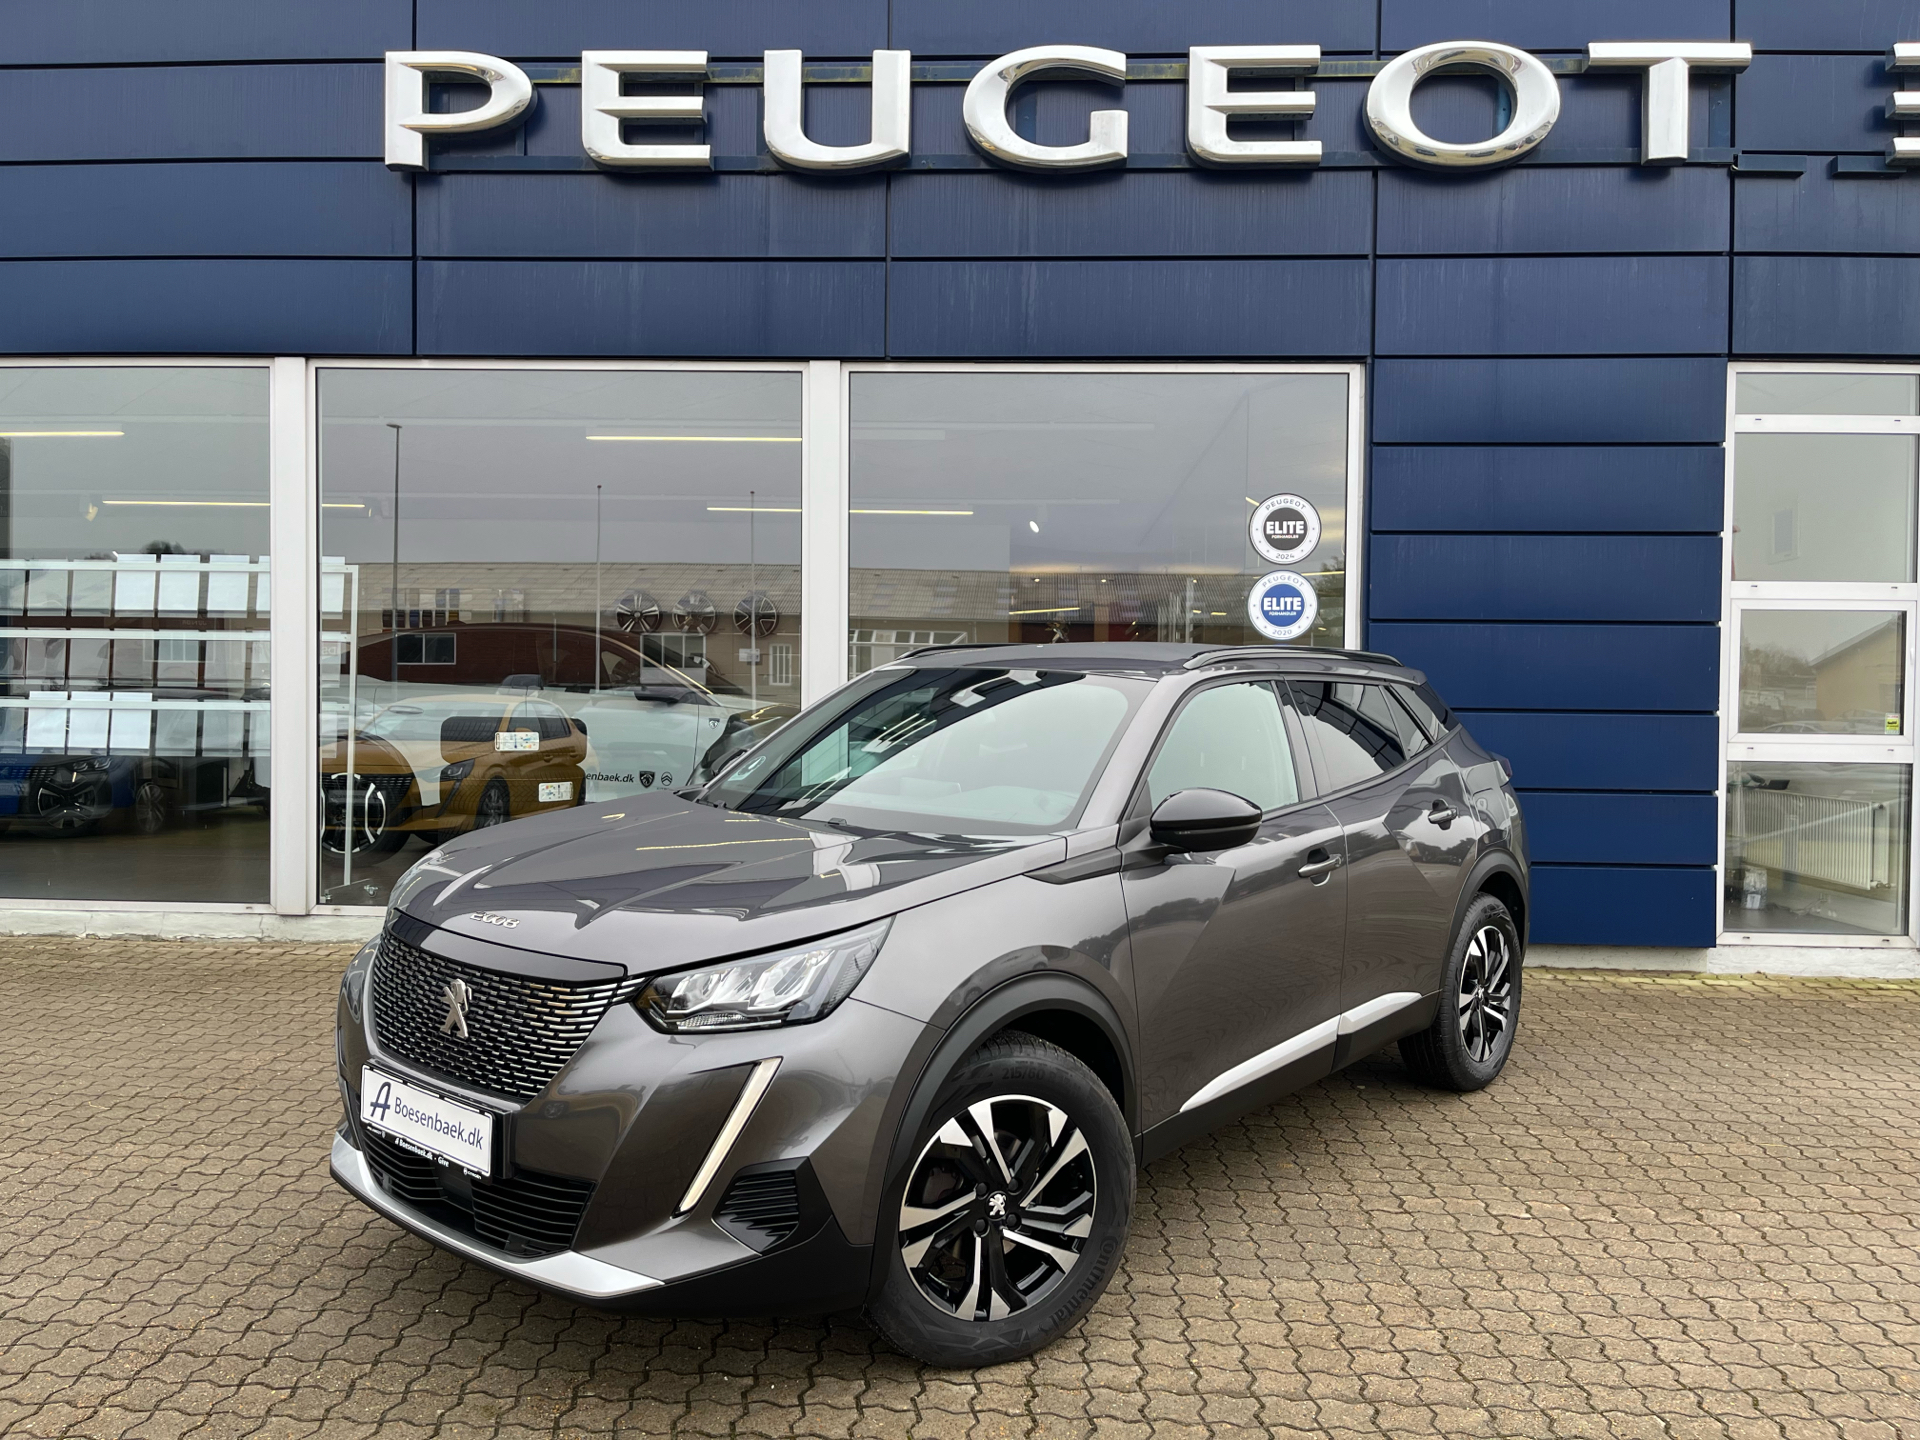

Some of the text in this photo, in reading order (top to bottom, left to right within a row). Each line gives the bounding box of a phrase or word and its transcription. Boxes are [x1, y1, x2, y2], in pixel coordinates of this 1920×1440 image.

[385, 40, 1752, 171] PEUGEOT
[1265, 498, 1307, 511] PEUGEOT
[1266, 521, 1305, 534] ELITE
[1275, 552, 1295, 560] 2024
[1262, 574, 1305, 588] PEUGEOT
[1263, 597, 1302, 611] ELITE
[470, 910, 520, 929] 2008
[1002, 1066, 1045, 1080] 215/60
[394, 1097, 484, 1150] Boesenbaek.dk
